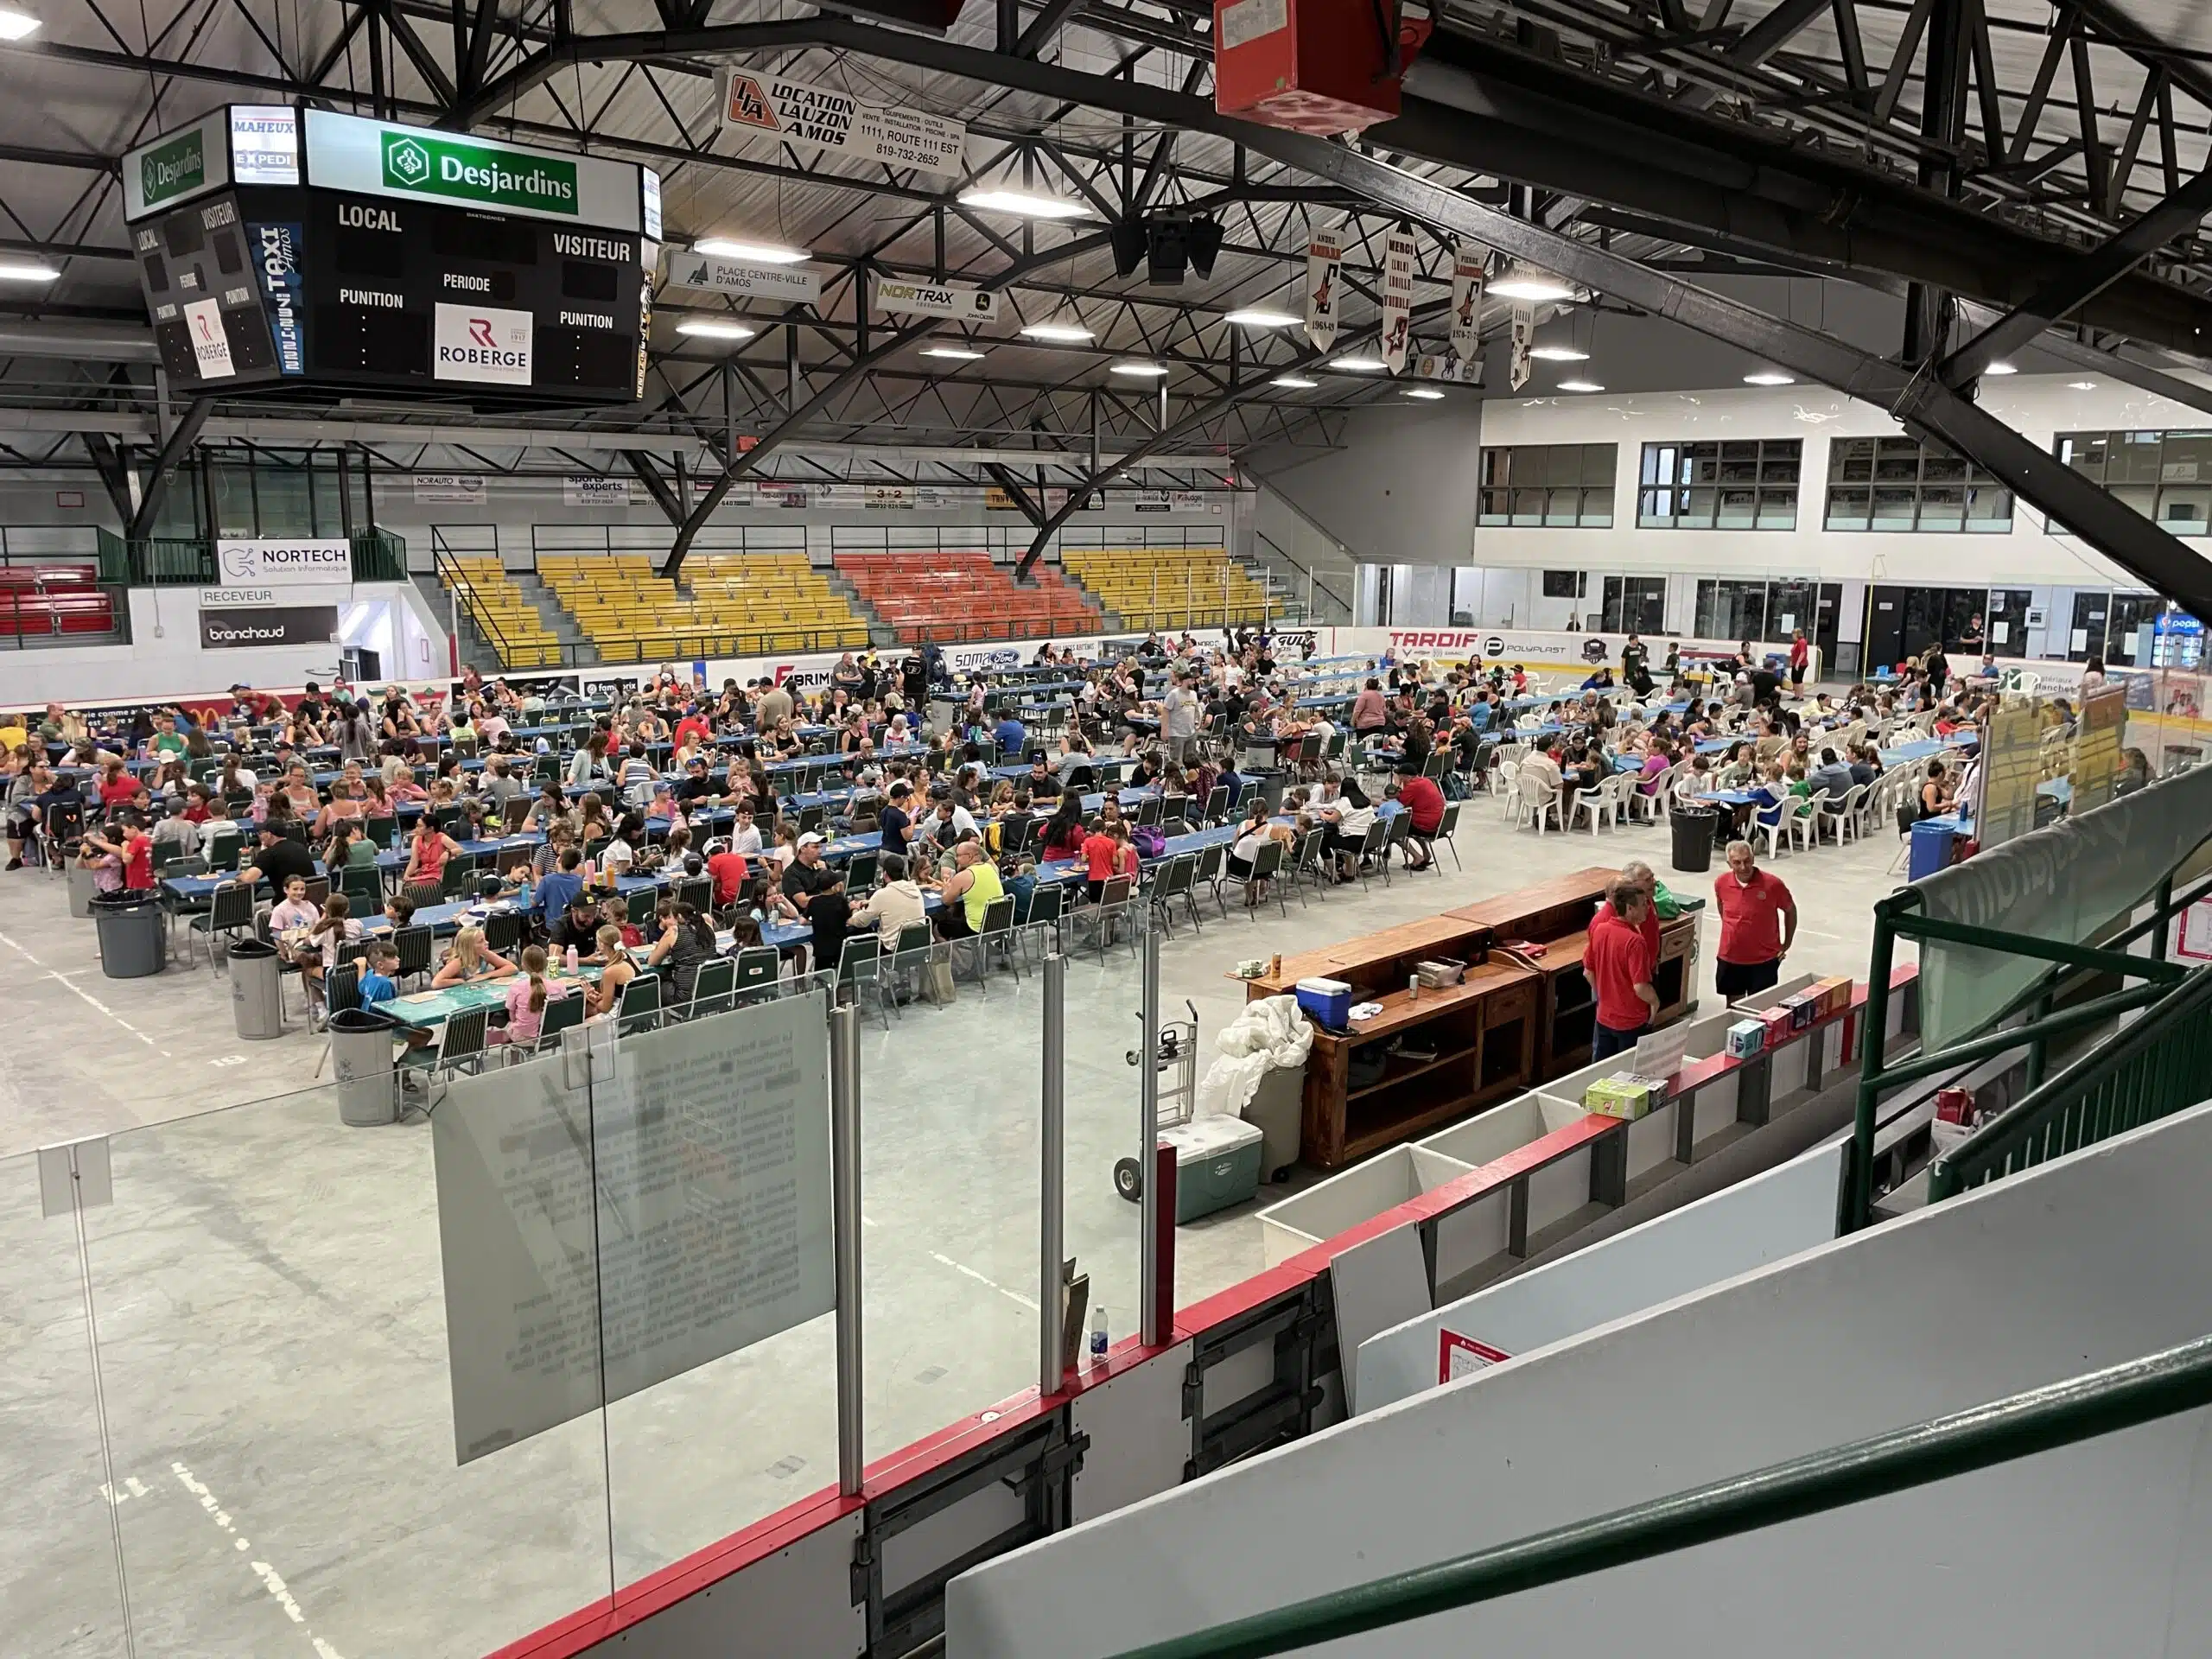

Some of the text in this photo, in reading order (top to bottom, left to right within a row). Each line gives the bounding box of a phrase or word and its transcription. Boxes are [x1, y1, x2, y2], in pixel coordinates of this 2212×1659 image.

[771, 83, 858, 116] LOCATION
[778, 101, 853, 130] LAUZON
[862, 112, 880, 123] VENTE
[233, 121, 295, 134] MAHEUX
[783, 121, 848, 146] AMOS
[861, 124, 959, 155] 1111, ROUTE 111 EST
[236, 151, 292, 167] EXPEDI
[876, 143, 940, 166] 819-732-2652
[157, 146, 202, 187] Desjardins
[441, 156, 573, 200] Desjardins
[200, 200, 236, 230] VISITEUR
[338, 204, 403, 232] LOCAL
[137, 228, 159, 251] LOCAL
[553, 232, 631, 262] VISITEUR
[1389, 238, 1414, 256] MERCI
[276, 227, 295, 273] Amos
[443, 273, 491, 292] PERIODE
[715, 276, 752, 289] D'AMOS
[716, 265, 808, 286] PLACE CENTRE-VILLE
[225, 287, 250, 305] PUNITION
[340, 289, 404, 308] PUNITION
[879, 283, 954, 305] NORTRAX
[559, 311, 613, 329] PUNITION
[196, 341, 229, 361] ROBERGE
[439, 346, 527, 367] ROBERGE
[582, 482, 623, 493] experts
[263, 549, 346, 563] NORTECH
[298, 564, 347, 574] Informatique
[204, 590, 273, 602] RECEVEUR
[209, 625, 285, 641] branchaud
[1389, 632, 1478, 648] TARDIF
[993, 651, 1016, 664] Ford
[1506, 645, 1567, 654] POLYPLAST
[98, 709, 129, 718] comme
